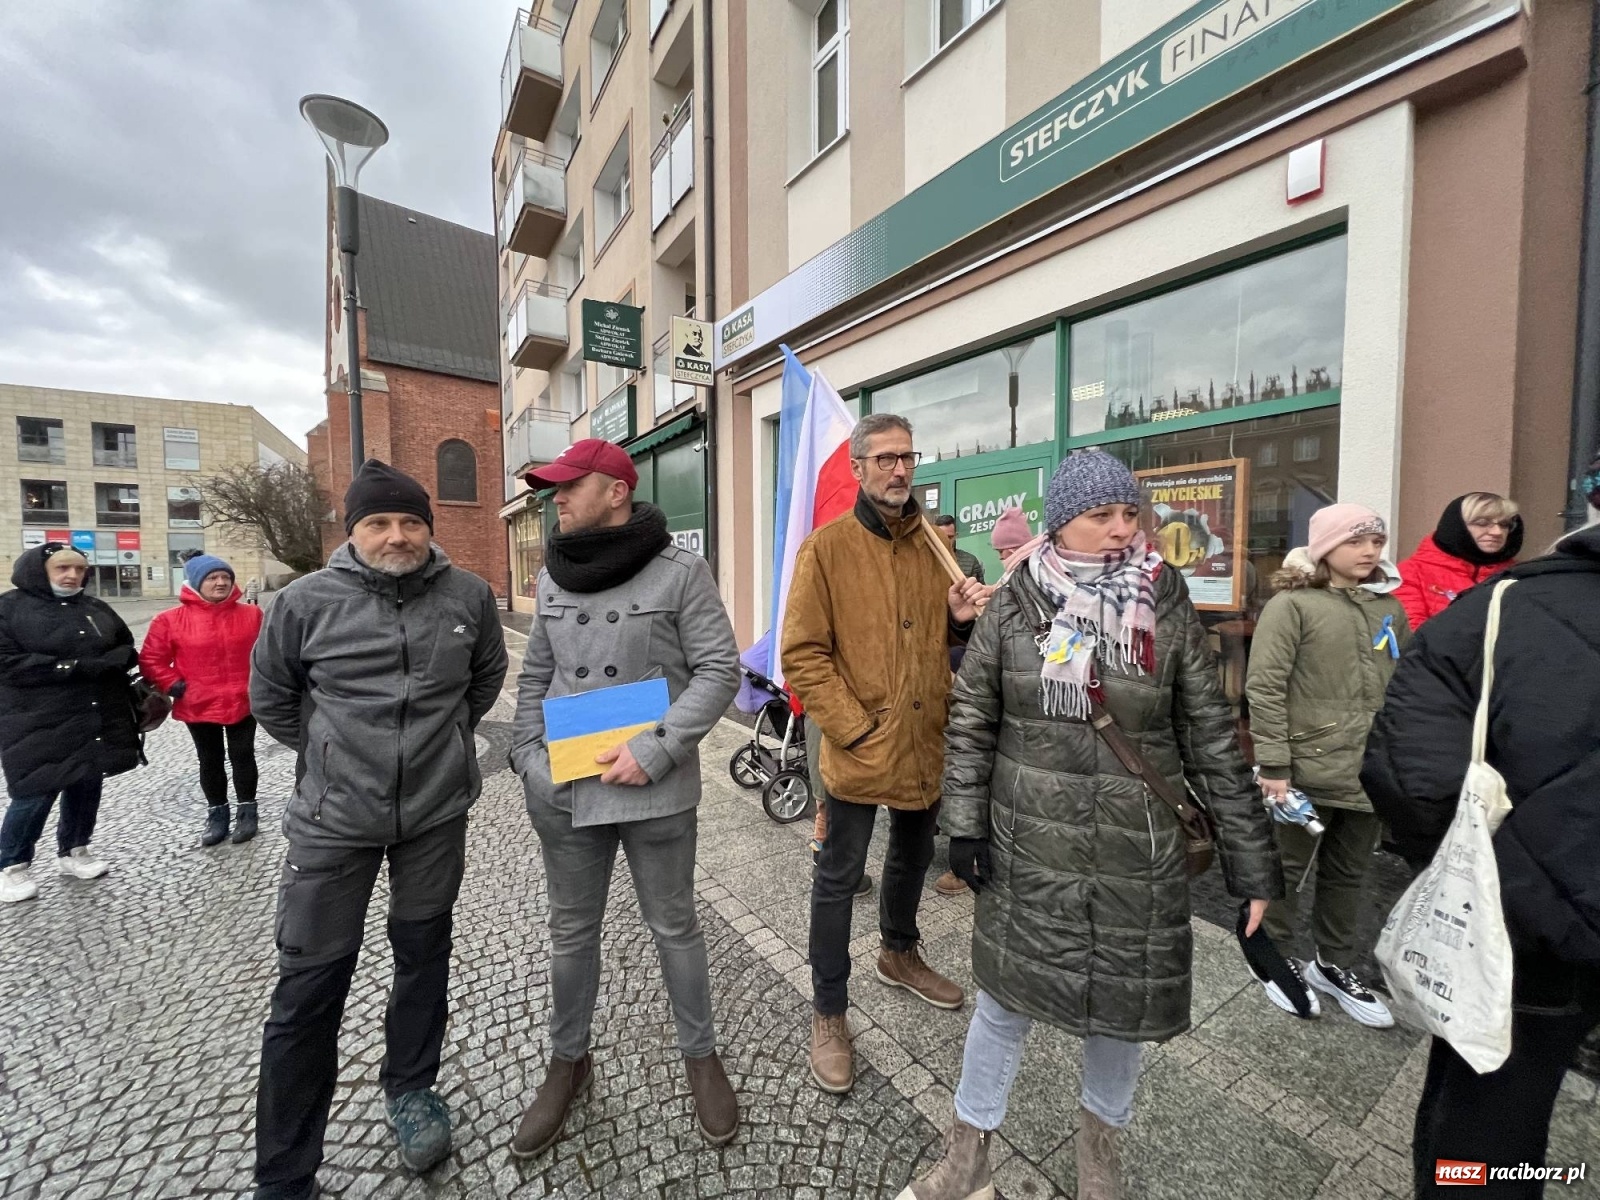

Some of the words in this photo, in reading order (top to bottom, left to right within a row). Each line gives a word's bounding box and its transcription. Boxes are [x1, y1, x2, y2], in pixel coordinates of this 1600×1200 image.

[1009, 60, 1150, 169] STEFCZYK
[731, 310, 752, 333] KASA
[600, 329, 625, 337] ADWOKAT
[723, 331, 753, 355] STEFCZYKA
[600, 354, 626, 362] ADWOKAT
[687, 361, 709, 372] KASY
[676, 370, 710, 381] STEFCZYKA
[1187, 476, 1197, 484] do
[1151, 484, 1223, 504] ZWYCIĘSKIE
[959, 492, 1027, 523] GRAMY
